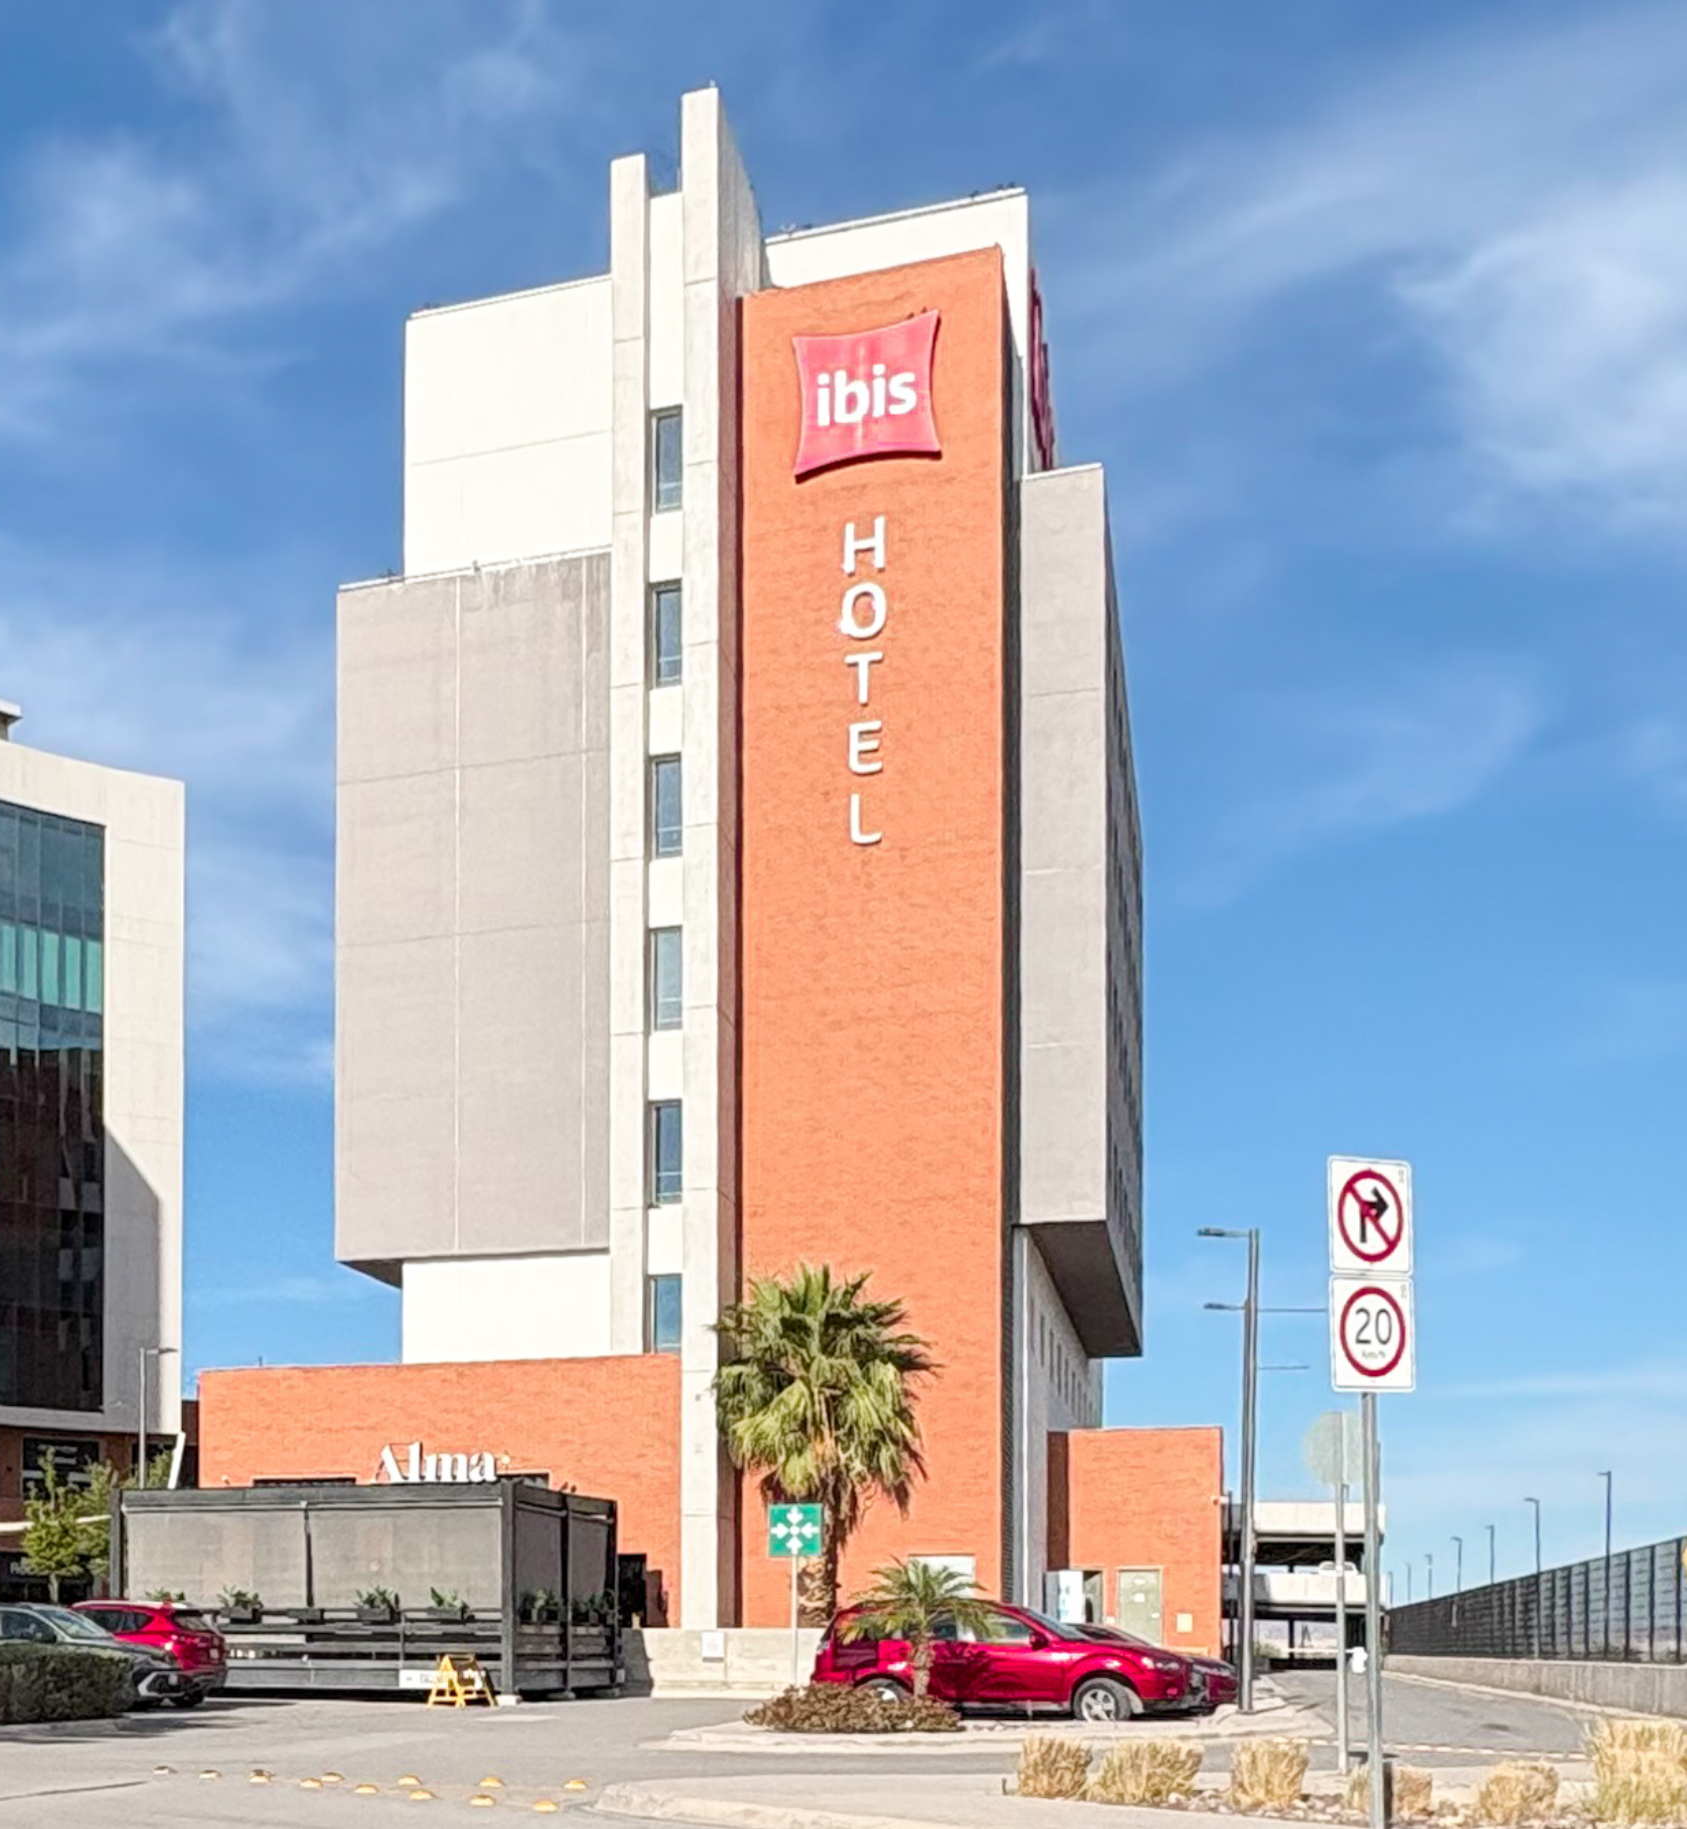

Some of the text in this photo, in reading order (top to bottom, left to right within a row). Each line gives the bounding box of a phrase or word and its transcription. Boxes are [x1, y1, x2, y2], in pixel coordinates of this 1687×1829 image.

[816, 363, 918, 427] ibis
[842, 515, 887, 845] HOTEL
[1354, 1307, 1393, 1346] 20
[370, 1441, 498, 1484] Alma
